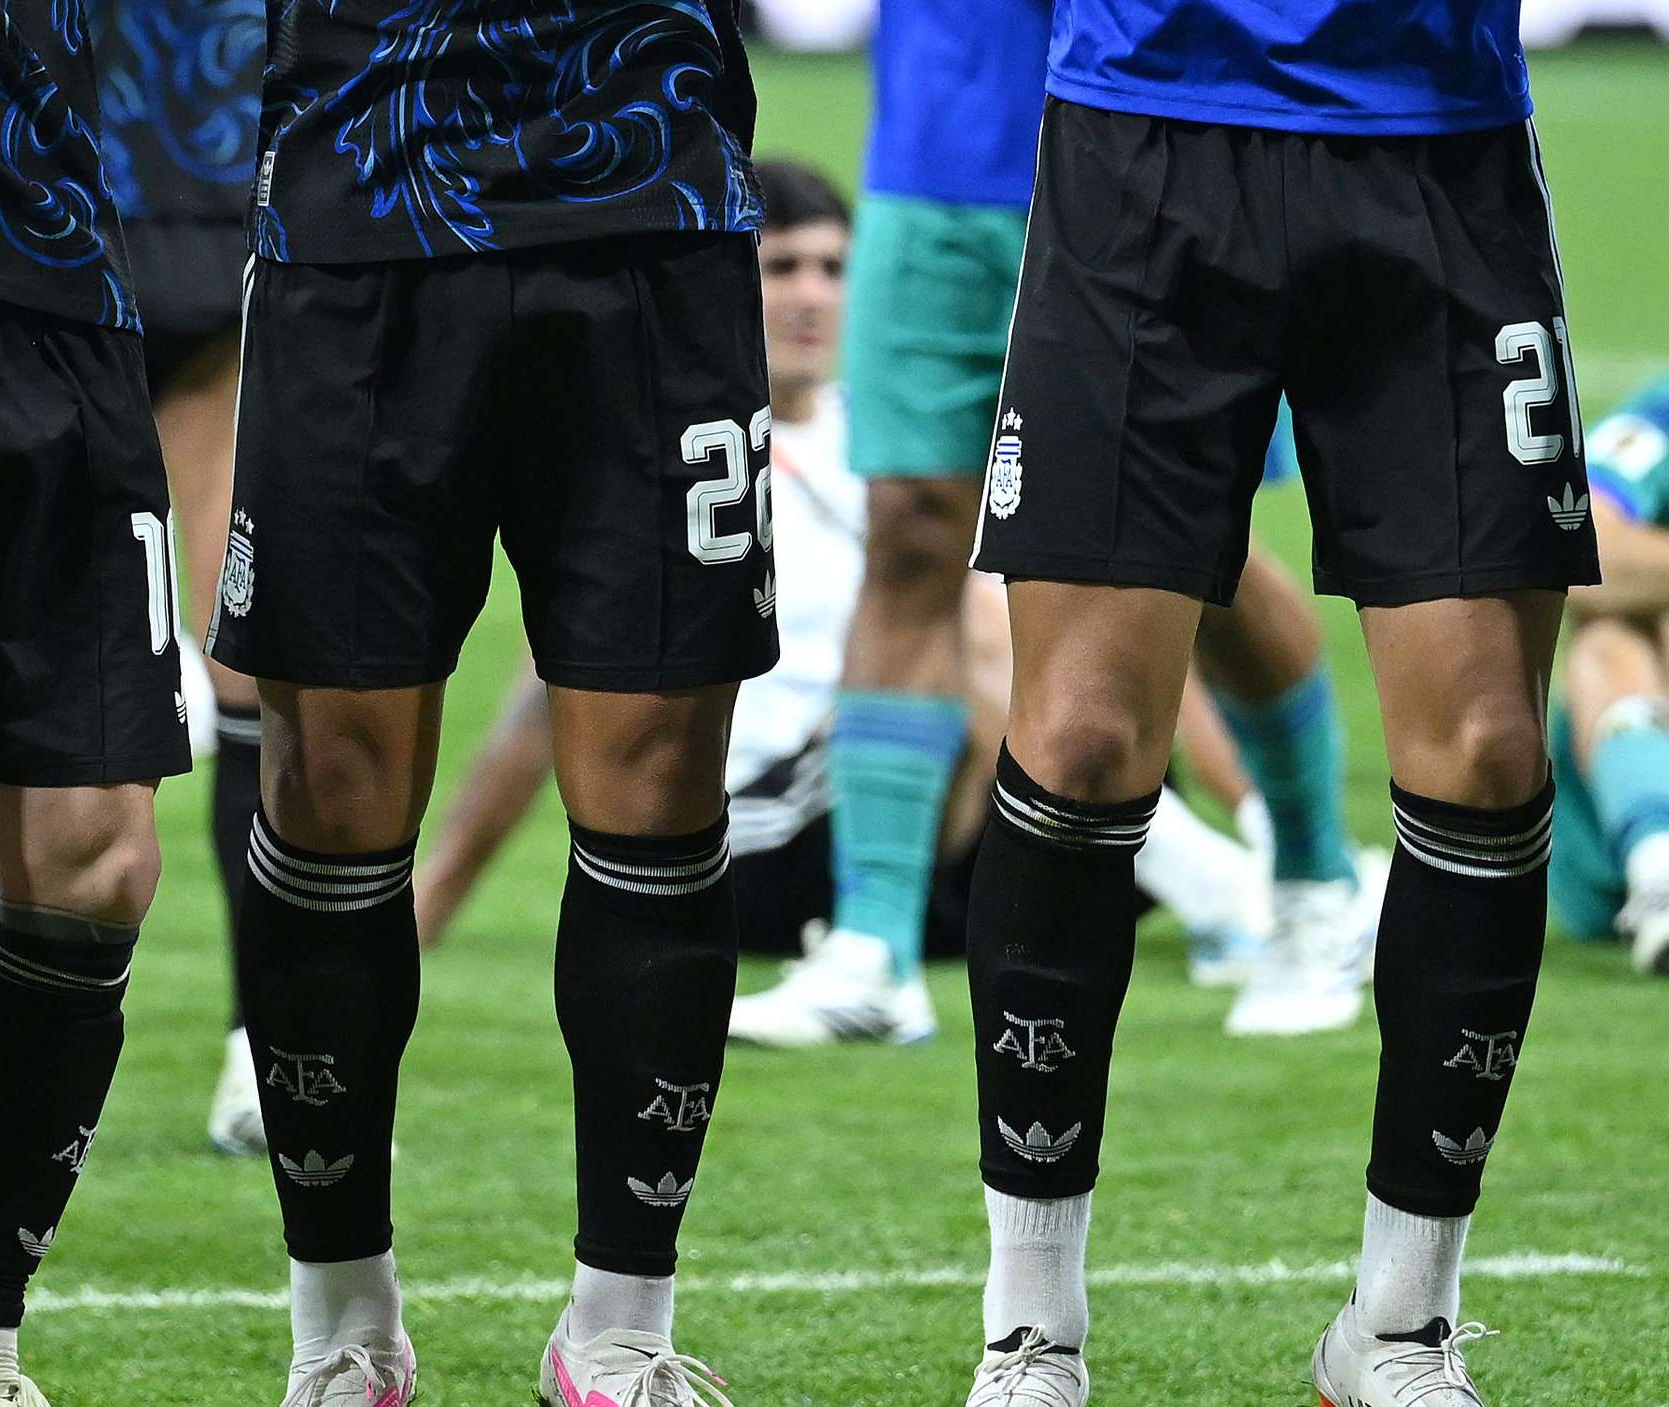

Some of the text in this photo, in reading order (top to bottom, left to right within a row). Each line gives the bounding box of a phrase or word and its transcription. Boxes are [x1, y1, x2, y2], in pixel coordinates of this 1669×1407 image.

[1495, 316, 1581, 466] 21
[993, 1011, 1076, 1073] AFA
[1442, 1027, 1518, 1082] AFA
[267, 1046, 346, 1106] AFA
[637, 1077, 711, 1132] AFA
